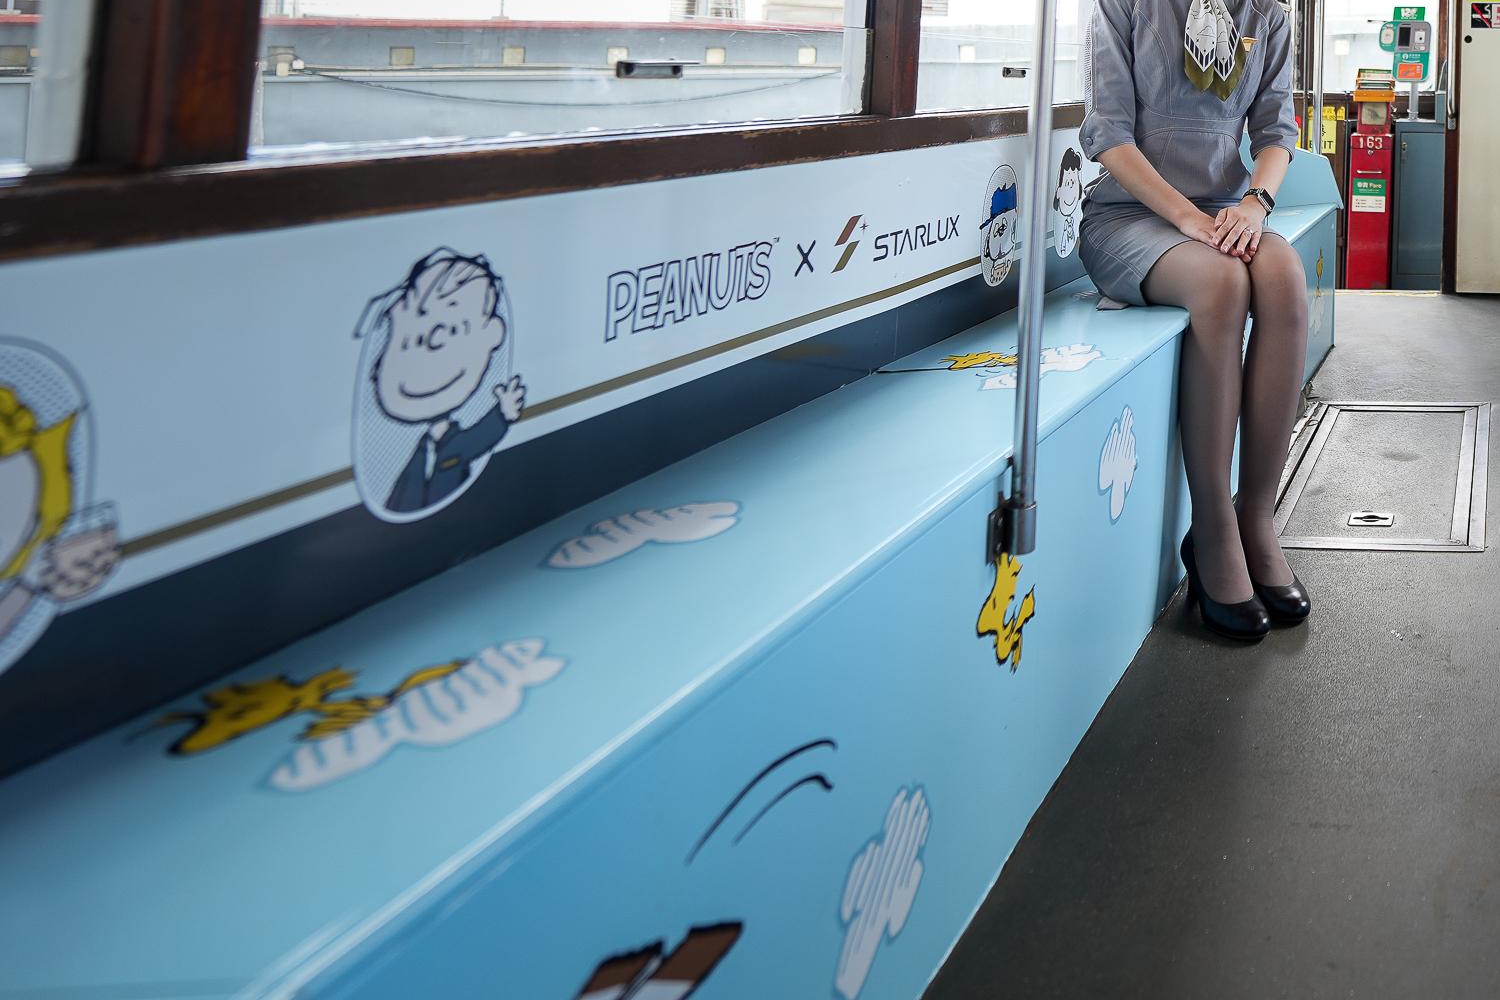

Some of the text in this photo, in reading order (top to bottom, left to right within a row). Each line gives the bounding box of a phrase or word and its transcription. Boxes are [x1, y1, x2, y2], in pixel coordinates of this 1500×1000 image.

[1358, 136, 1384, 150] 163
[603, 241, 774, 344] PEANUTS
[873, 214, 960, 262] STARLUX
